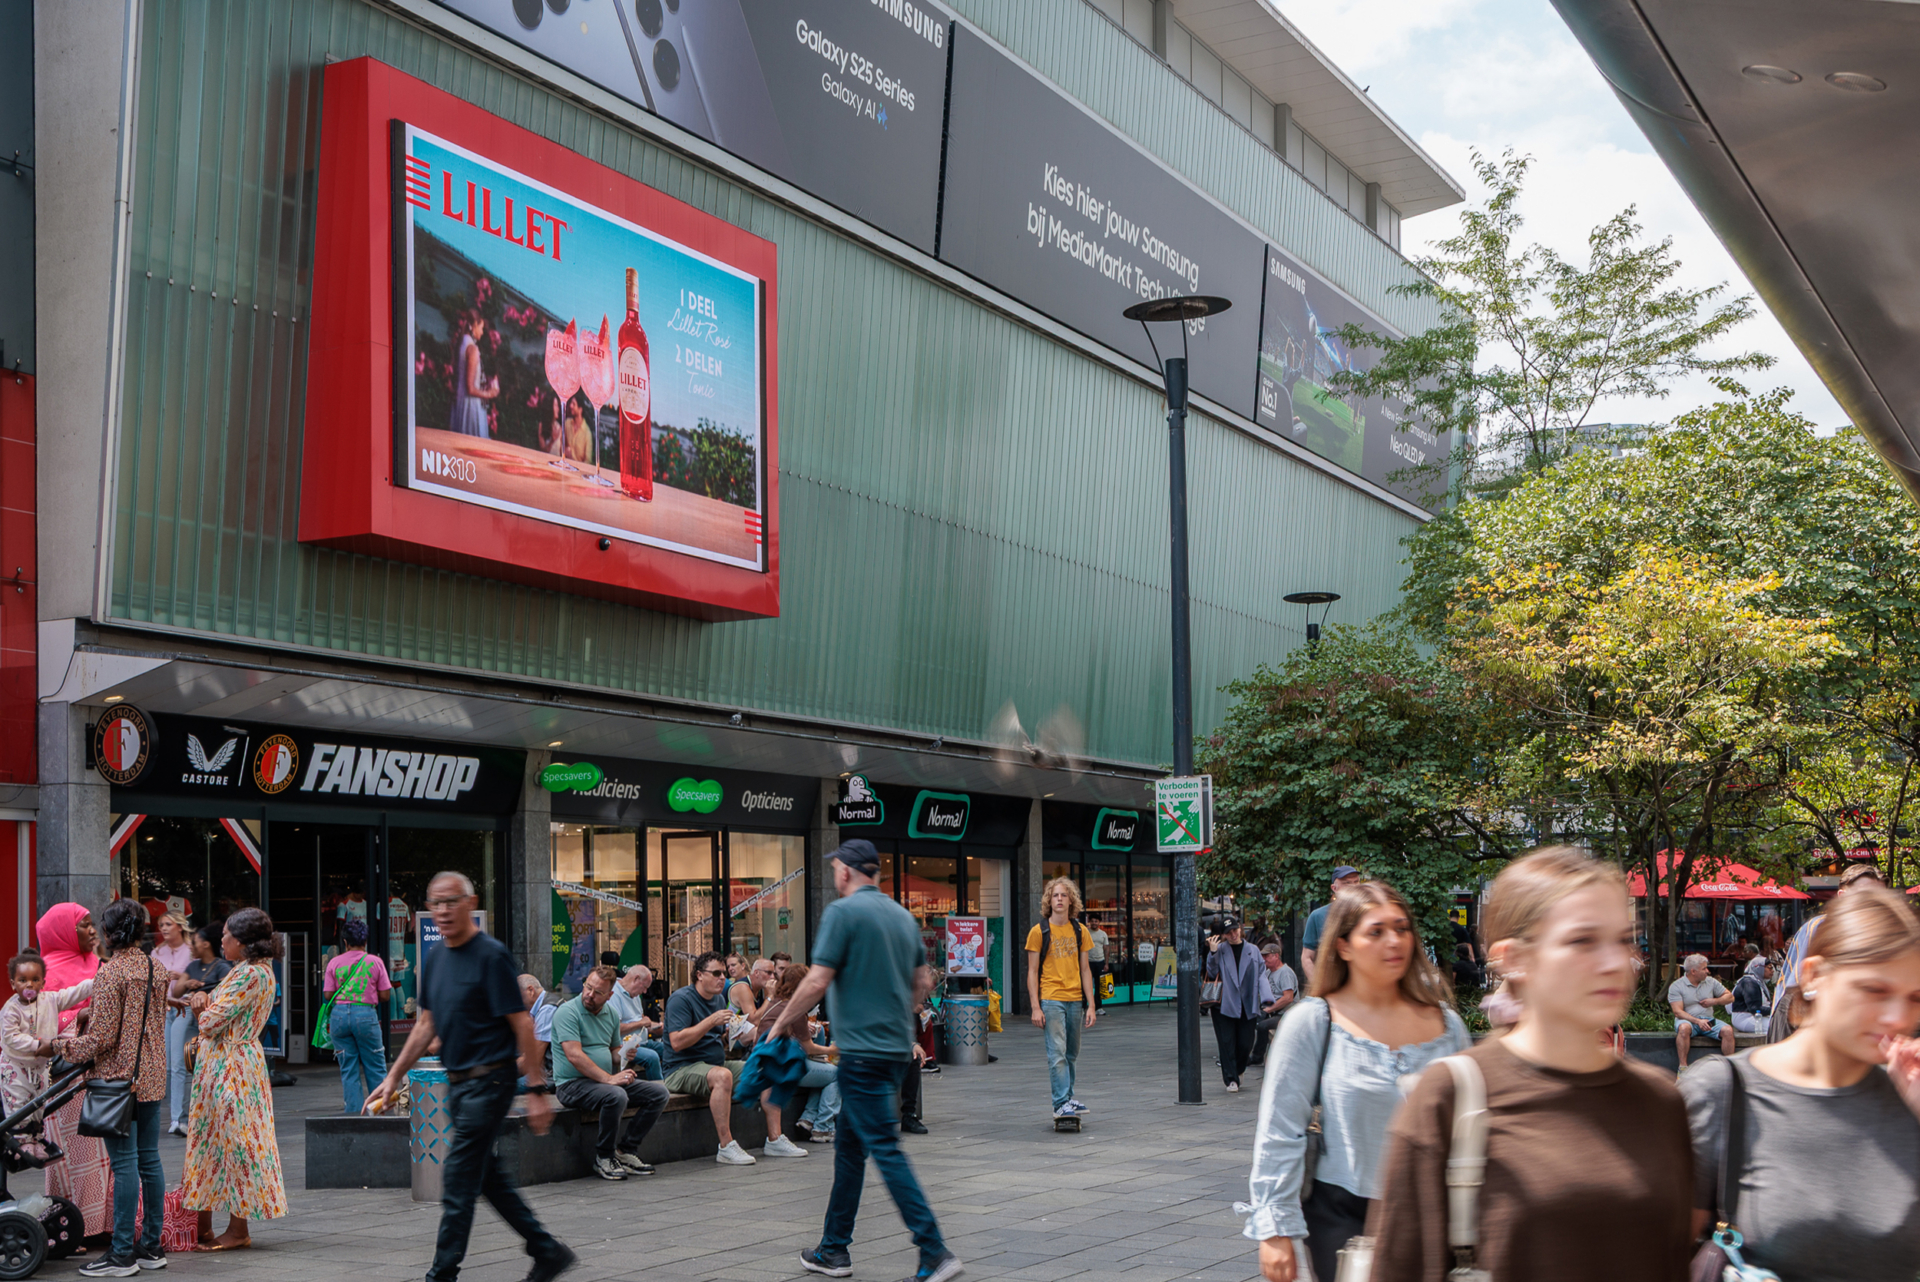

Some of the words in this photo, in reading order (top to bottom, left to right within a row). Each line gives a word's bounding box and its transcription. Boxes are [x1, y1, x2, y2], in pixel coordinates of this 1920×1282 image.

[870, 0, 944, 49] MSUNG
[796, 19, 849, 75] Galaxy
[849, 52, 874, 85] S25
[874, 68, 915, 112] Series
[821, 72, 864, 117] Galaxy
[864, 99, 876, 120] AI
[442, 169, 569, 263] LILLET
[1043, 163, 1074, 206] Kies
[1076, 183, 1104, 224] hier
[1104, 200, 1140, 247] jouw
[1141, 227, 1199, 293] Samsung
[1027, 202, 1047, 248] bij
[1048, 214, 1132, 289] MediaMarkt
[1135, 266, 1164, 300] Tech
[1270, 257, 1306, 295] SAMSUNG
[688, 290, 718, 320] DEEL
[667, 308, 702, 338] Lillet
[703, 321, 732, 349] Rosé
[553, 340, 573, 354] LILLET
[584, 345, 605, 359] LILLET
[675, 343, 682, 363] 2
[685, 347, 722, 377] DELEN
[620, 372, 647, 391] LILLET
[686, 369, 716, 399] Tonic
[1408, 424, 1428, 445] amsung
[422, 448, 477, 484] NIX18
[99, 708, 145, 736] FEYENOORD
[259, 736, 297, 758] FEYENOORD
[99, 753, 146, 782] ROTTERDAM
[181, 773, 229, 785] CASTORE
[300, 743, 480, 801] FANSHOP
[543, 770, 592, 782] Specsavers
[256, 770, 293, 792] ROTTERDAM
[1158, 781, 1199, 790] Verboden
[675, 788, 720, 803] Specsavers
[741, 790, 794, 812] Opticiens
[1169, 791, 1199, 799] voeren
[839, 805, 876, 820] Normal
[927, 805, 964, 828] Normal
[1107, 820, 1135, 840] Normal
